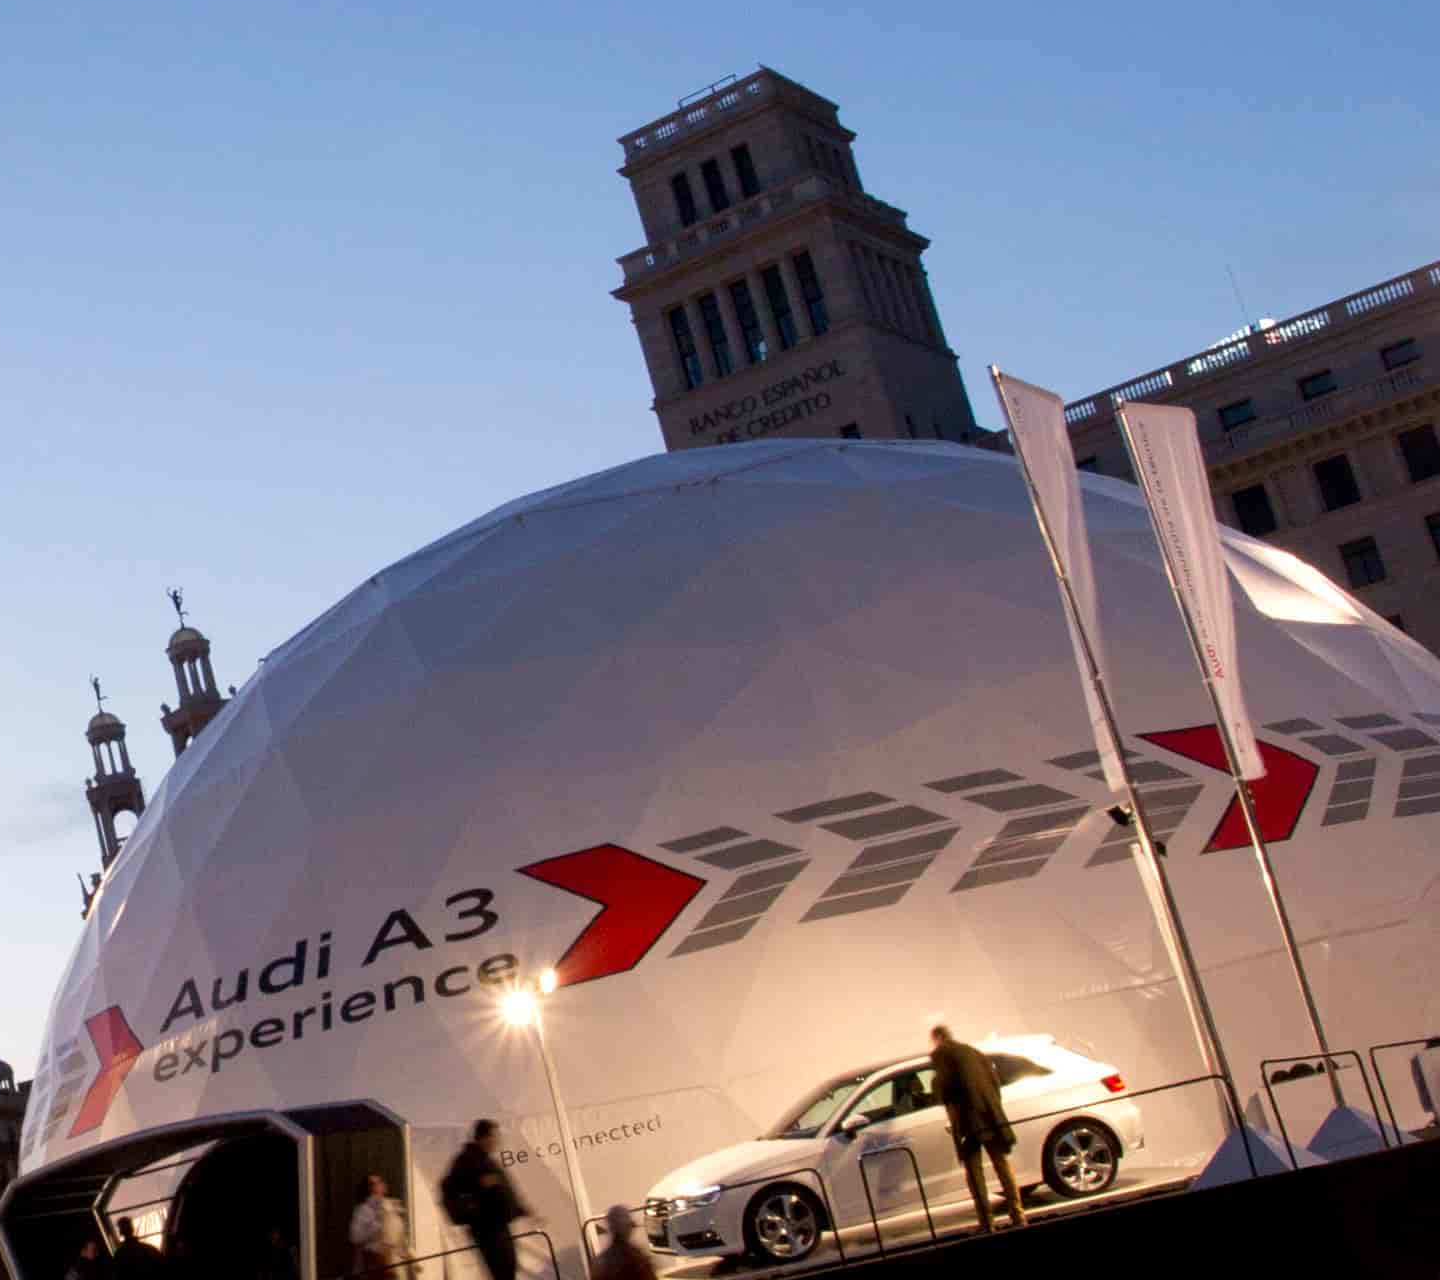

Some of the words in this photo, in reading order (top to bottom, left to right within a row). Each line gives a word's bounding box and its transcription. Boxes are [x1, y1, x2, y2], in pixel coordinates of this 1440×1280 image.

[688, 395, 757, 435] BANCO
[159, 931, 333, 1034] Audi
[360, 887, 499, 969] A3
[152, 952, 521, 1083] experience
[499, 1138, 529, 1168] Be
